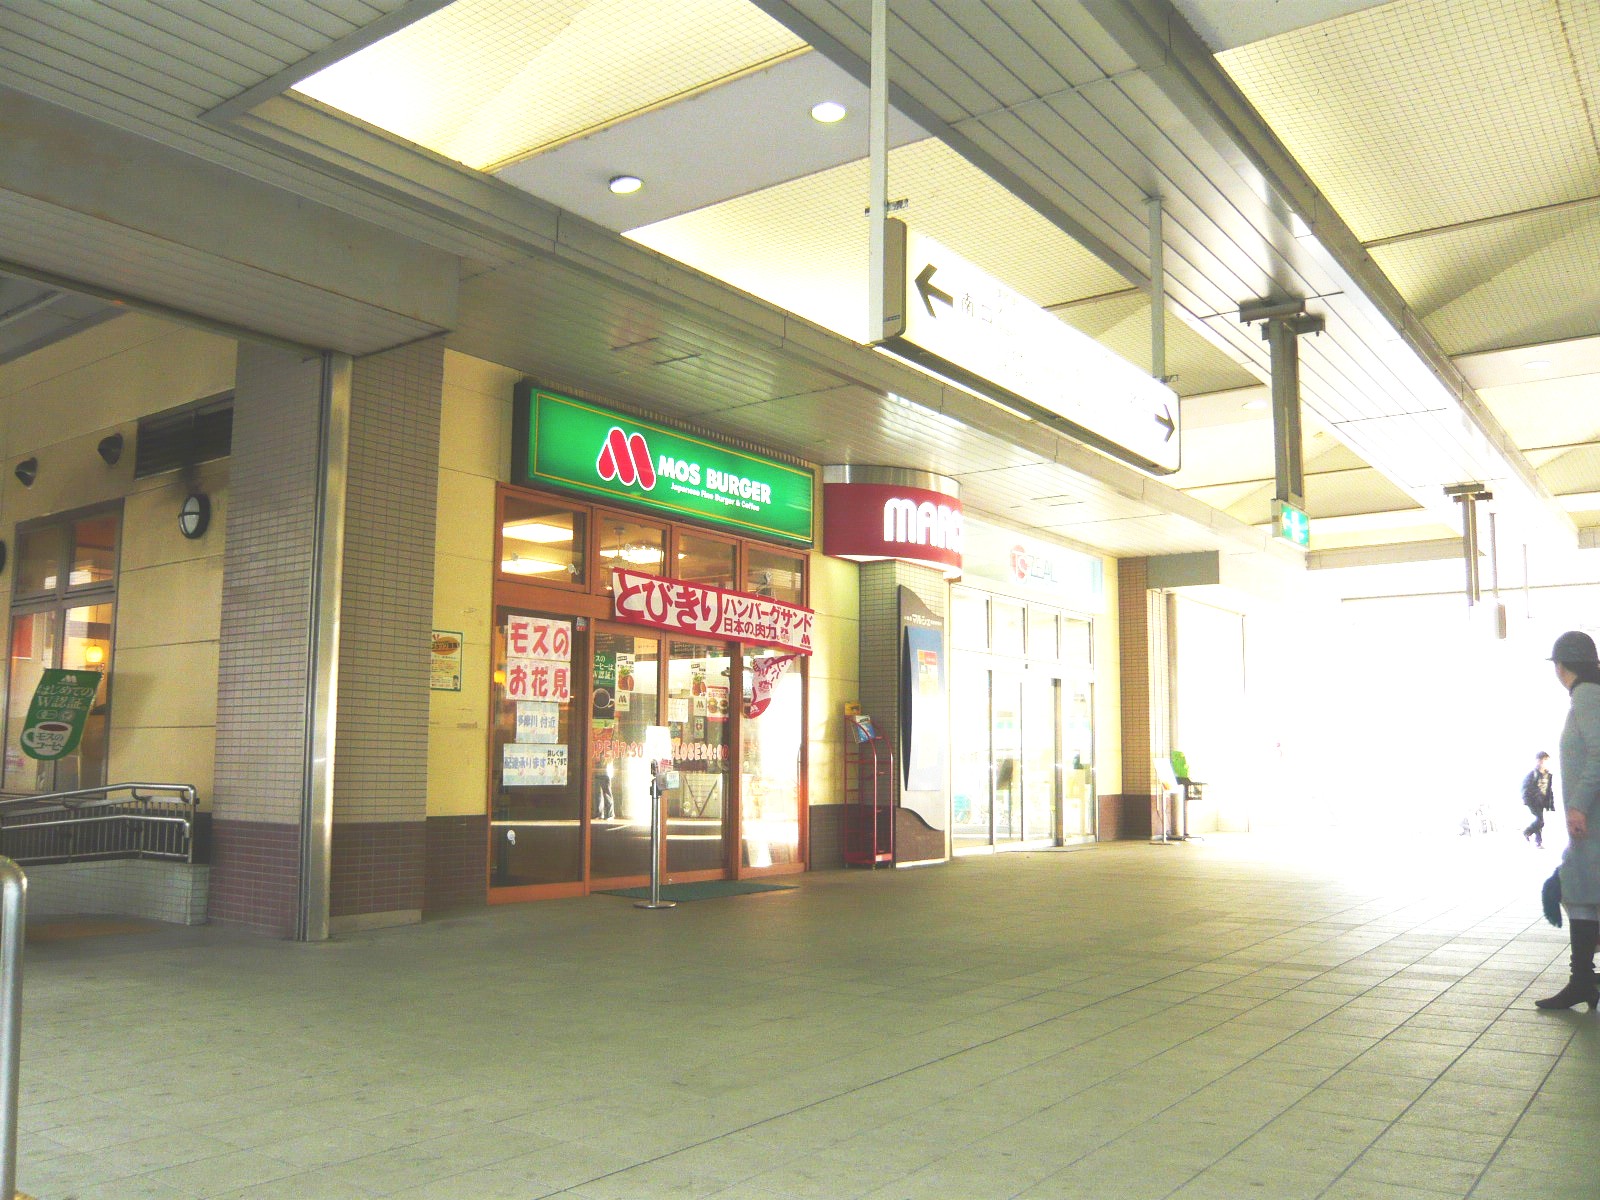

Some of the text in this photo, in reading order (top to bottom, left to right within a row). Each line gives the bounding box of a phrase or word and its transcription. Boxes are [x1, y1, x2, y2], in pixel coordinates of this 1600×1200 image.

[657, 455, 771, 505] MOS BURGER
[615, 572, 723, 634] とびきり
[724, 598, 813, 633] ハンバーグサンド
[510, 622, 569, 657] モスの
[509, 665, 568, 699] お花見
